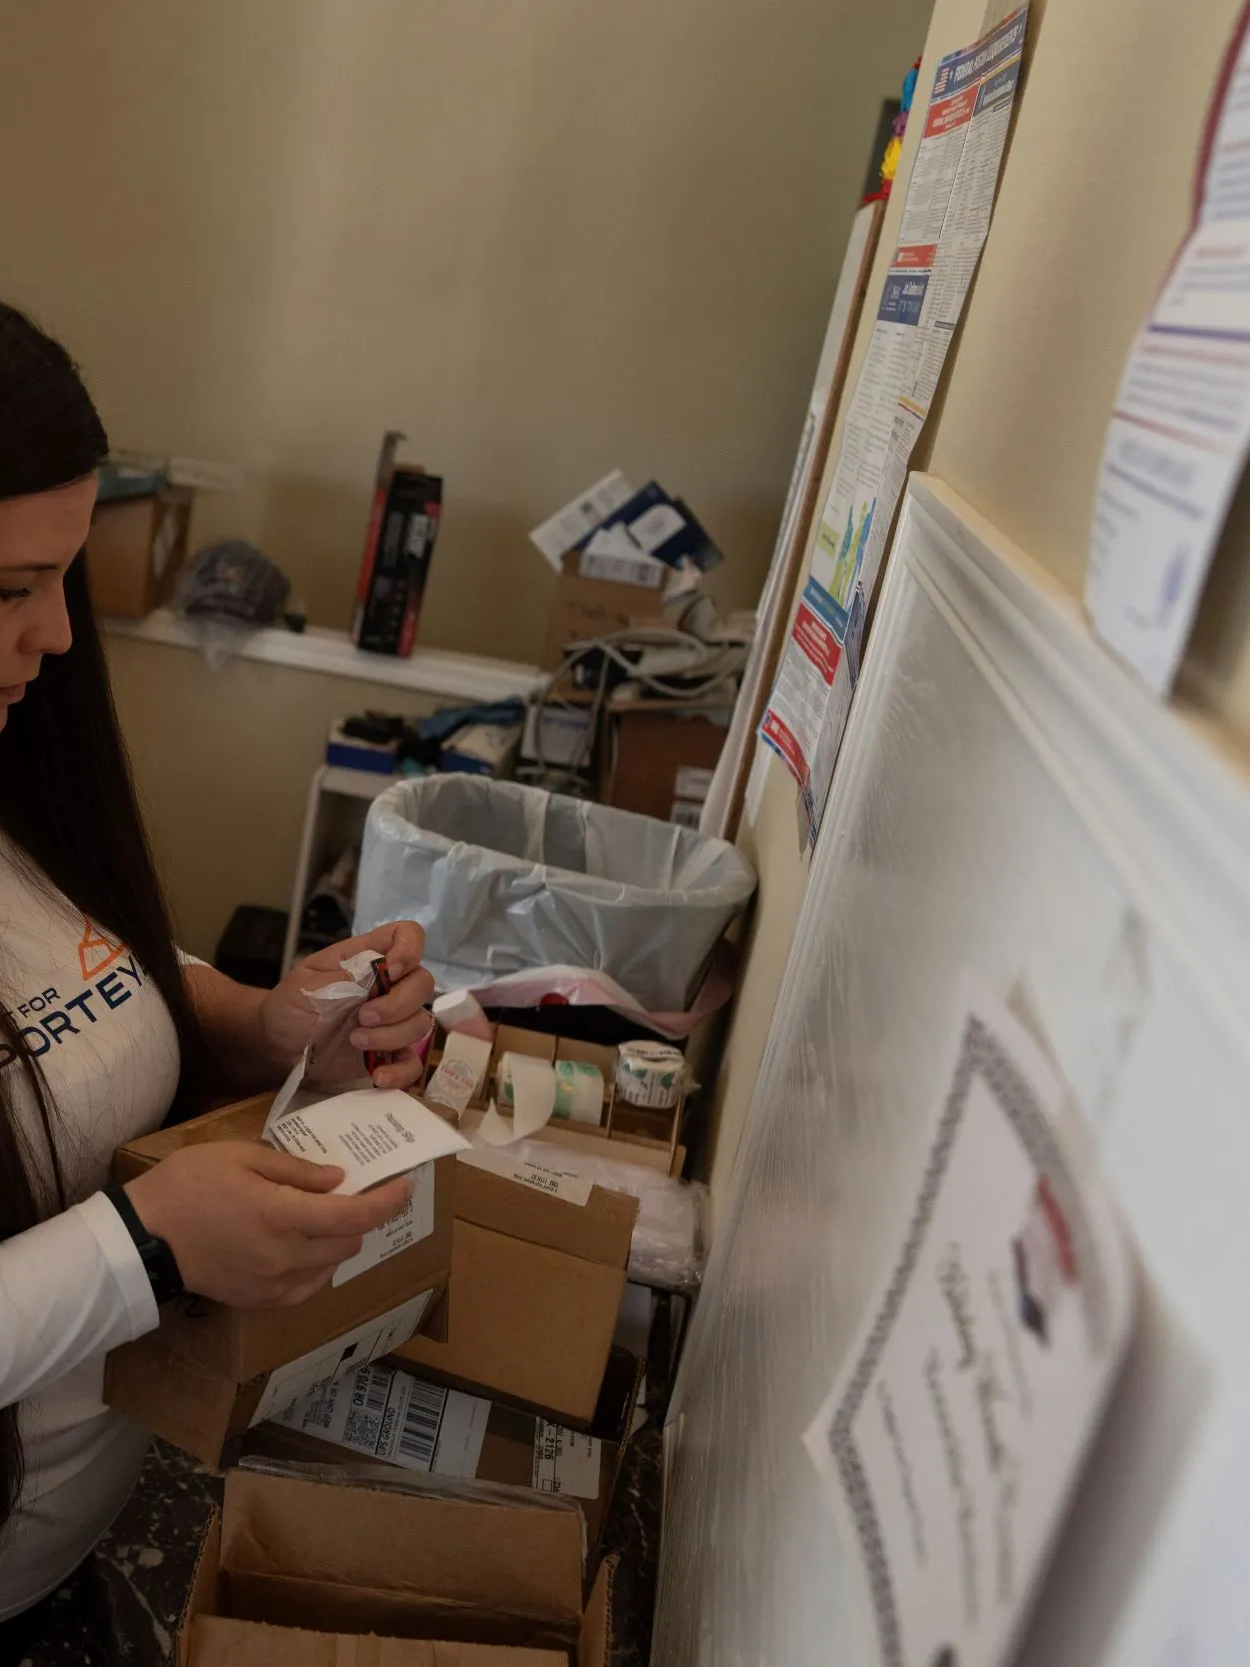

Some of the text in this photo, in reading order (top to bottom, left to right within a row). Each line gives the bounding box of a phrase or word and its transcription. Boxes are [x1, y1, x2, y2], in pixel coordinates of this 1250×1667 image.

[16, 987, 61, 1018] FOR
[377, 1407, 396, 1456] UPS GROUND
